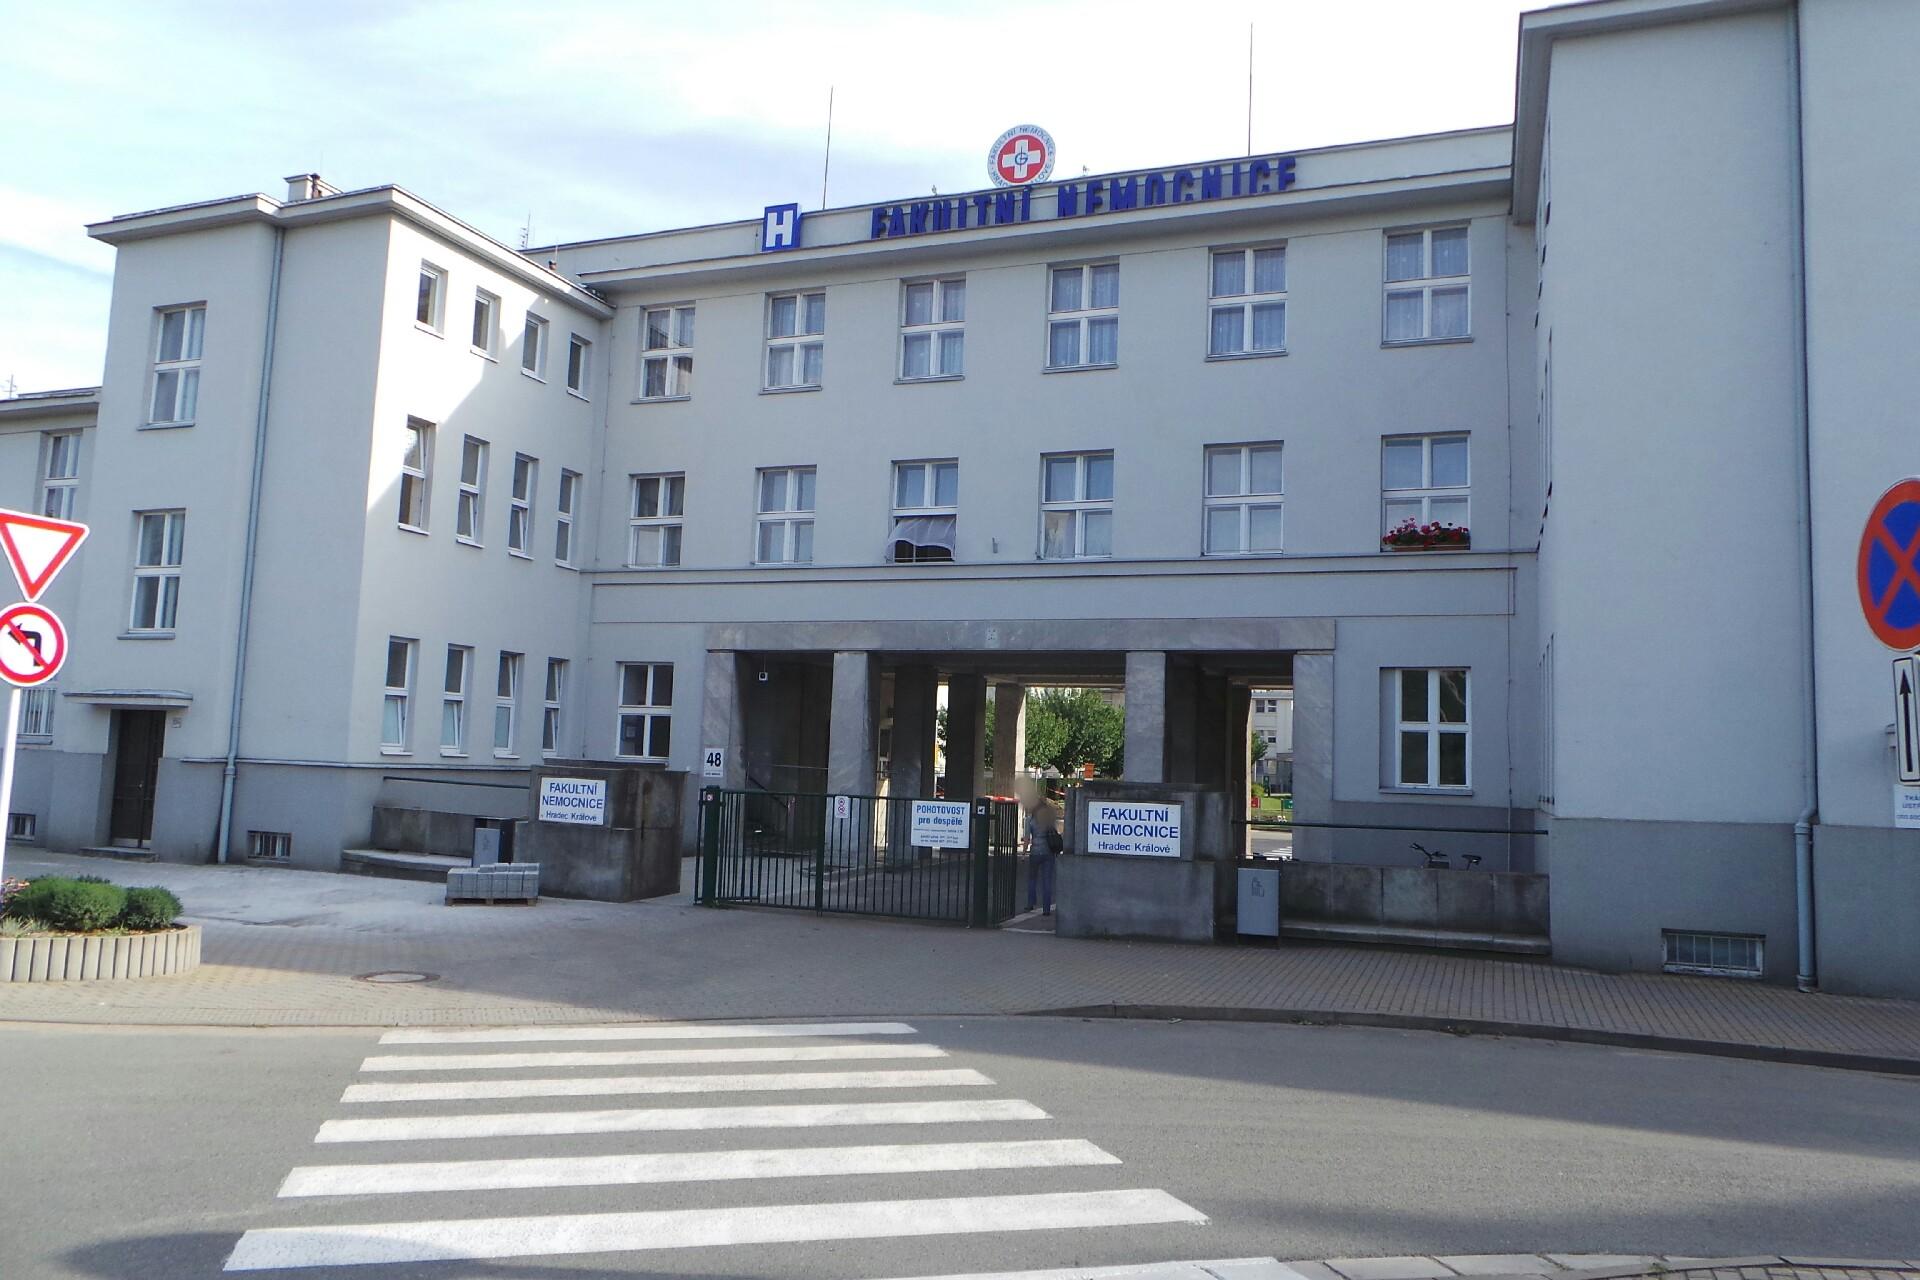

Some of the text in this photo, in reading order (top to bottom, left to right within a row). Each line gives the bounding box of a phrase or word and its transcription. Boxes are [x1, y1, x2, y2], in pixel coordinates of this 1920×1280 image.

[765, 210, 794, 248] H
[706, 752, 721, 767] 48
[549, 782, 598, 795] FAKULTNÍ
[542, 795, 603, 809] NEMOCNICE
[916, 805, 965, 815] POHOTOVOST
[1101, 808, 1169, 822] FAKULTNÍ
[933, 816, 963, 827] dospělé
[1091, 823, 1179, 838] NEMOCNICE
[1098, 841, 1170, 853] Hradec Králové
